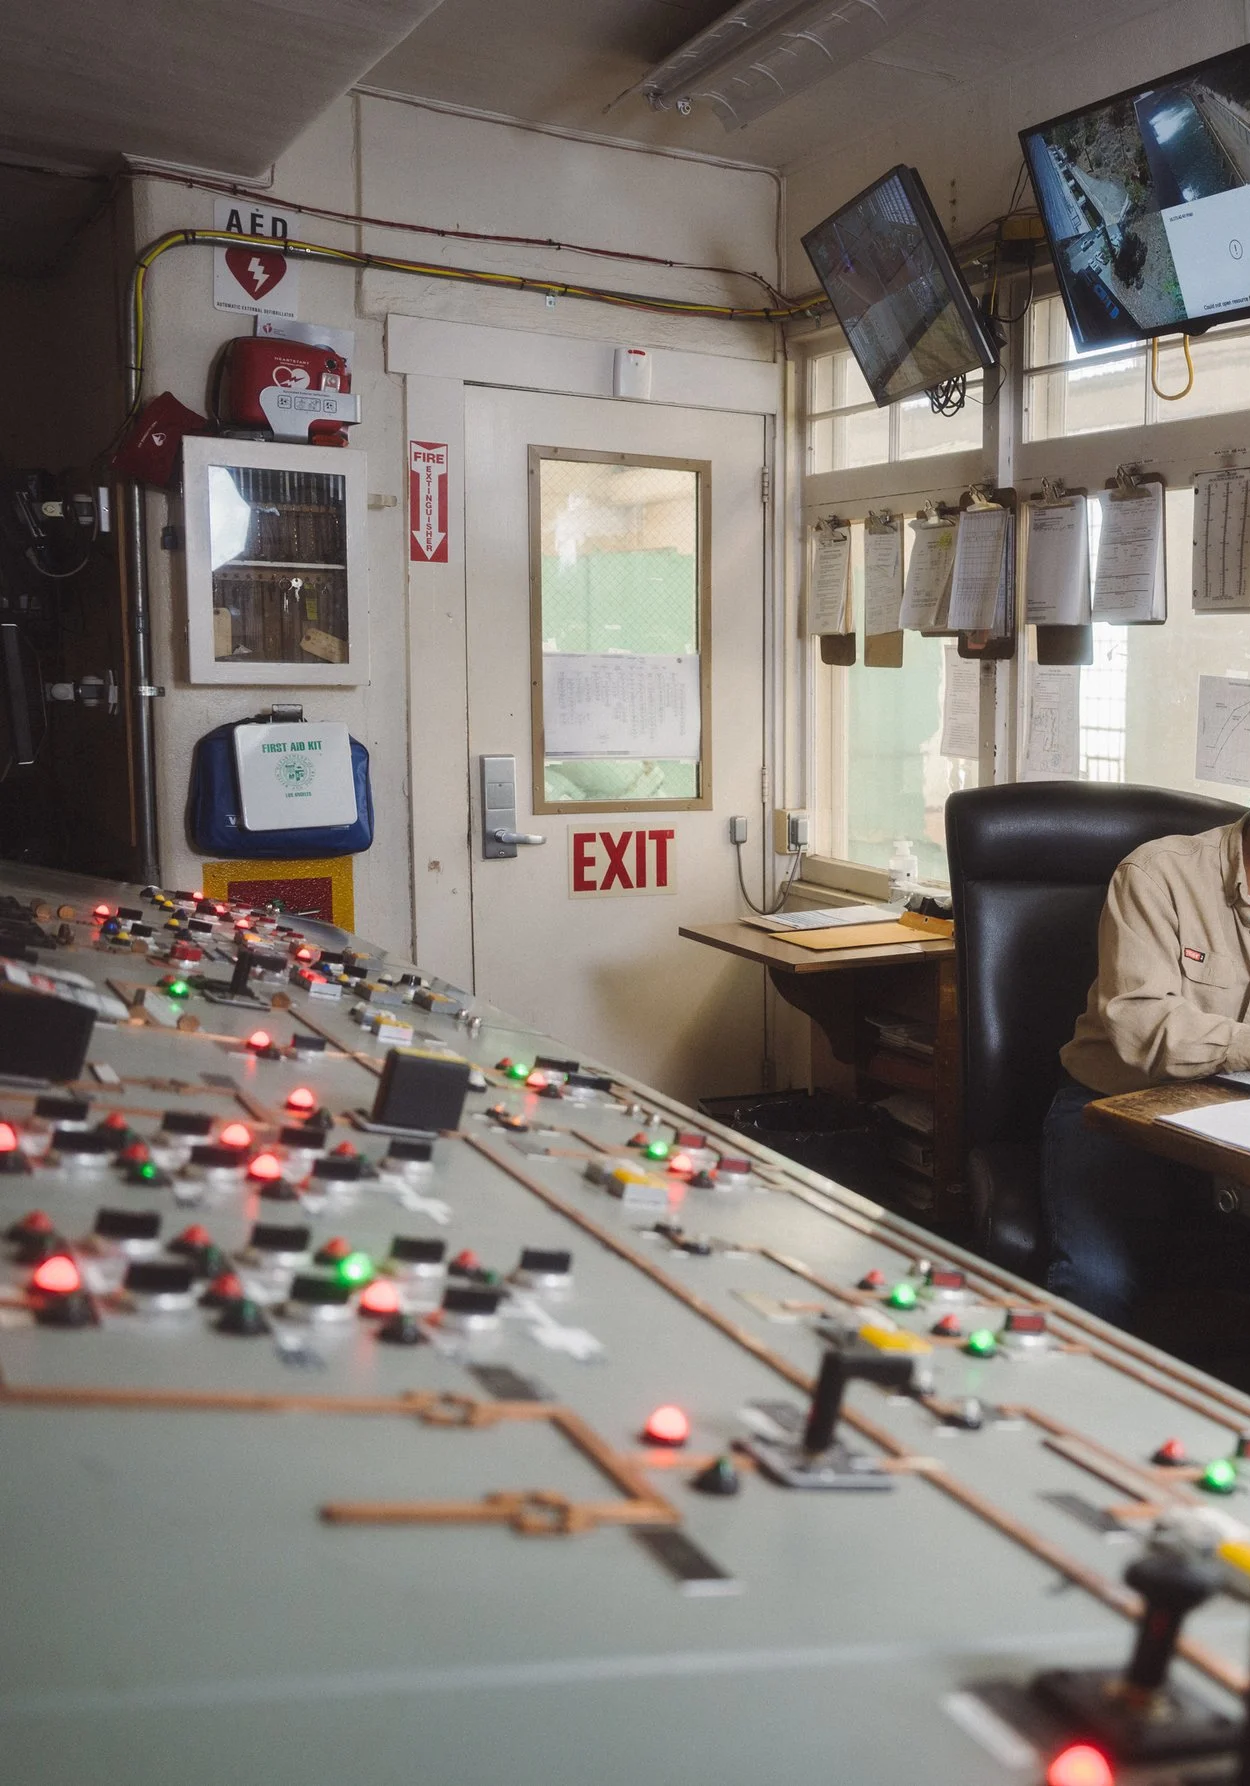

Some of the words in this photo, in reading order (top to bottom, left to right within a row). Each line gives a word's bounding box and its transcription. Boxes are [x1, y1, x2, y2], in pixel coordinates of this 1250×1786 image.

[225, 208, 288, 239] AED
[216, 301, 241, 310] AUTOMATIC
[241, 305, 263, 313] EXTERNAL
[263, 308, 294, 318] DEFIBRILLATOR
[1203, 302, 1215, 311] Could
[1222, 299, 1232, 307] open
[1231, 296, 1248, 305] resource
[274, 356, 310, 365] HEARTSTART
[413, 451, 444, 464] FIRE
[425, 466, 433, 552] EXTINGUISHER
[261, 742, 288, 753] FIRST
[290, 741, 306, 752] AID
[307, 740, 323, 750] KIT
[572, 829, 675, 892] EXIT
